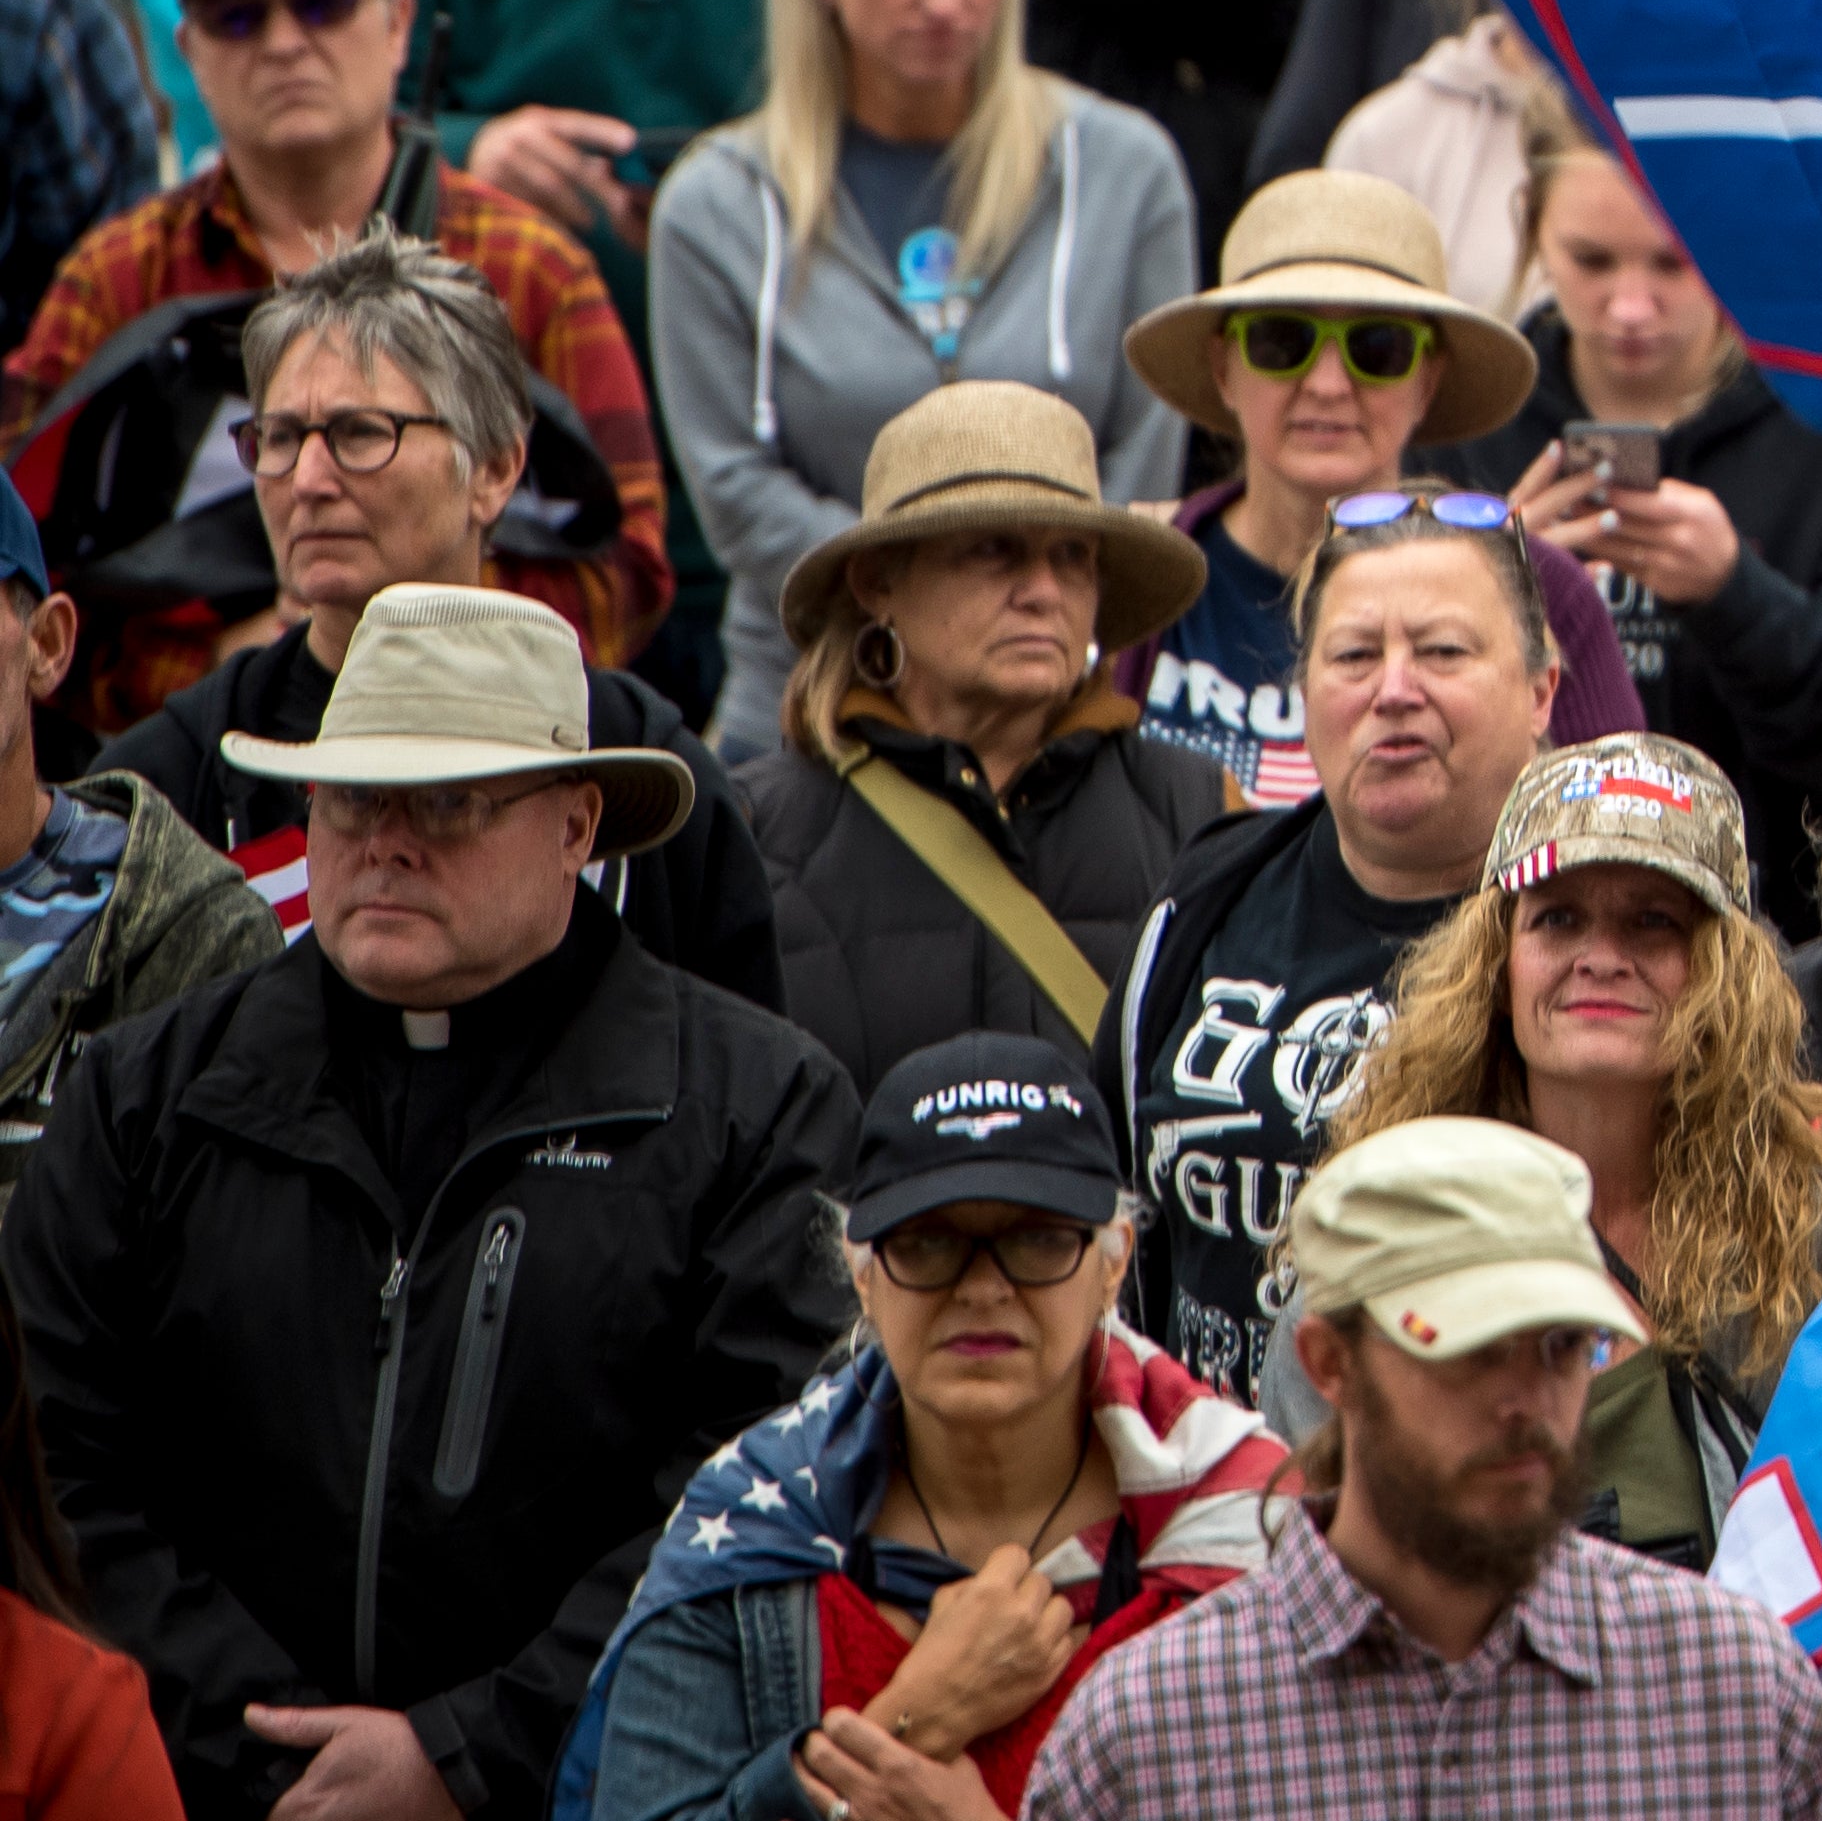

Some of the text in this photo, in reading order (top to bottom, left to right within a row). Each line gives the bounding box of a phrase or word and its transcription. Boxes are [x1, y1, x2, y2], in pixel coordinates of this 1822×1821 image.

[1566, 747, 1694, 803] Trump
[1599, 793, 1663, 821] 2020
[1175, 1150, 1318, 1246] GU
